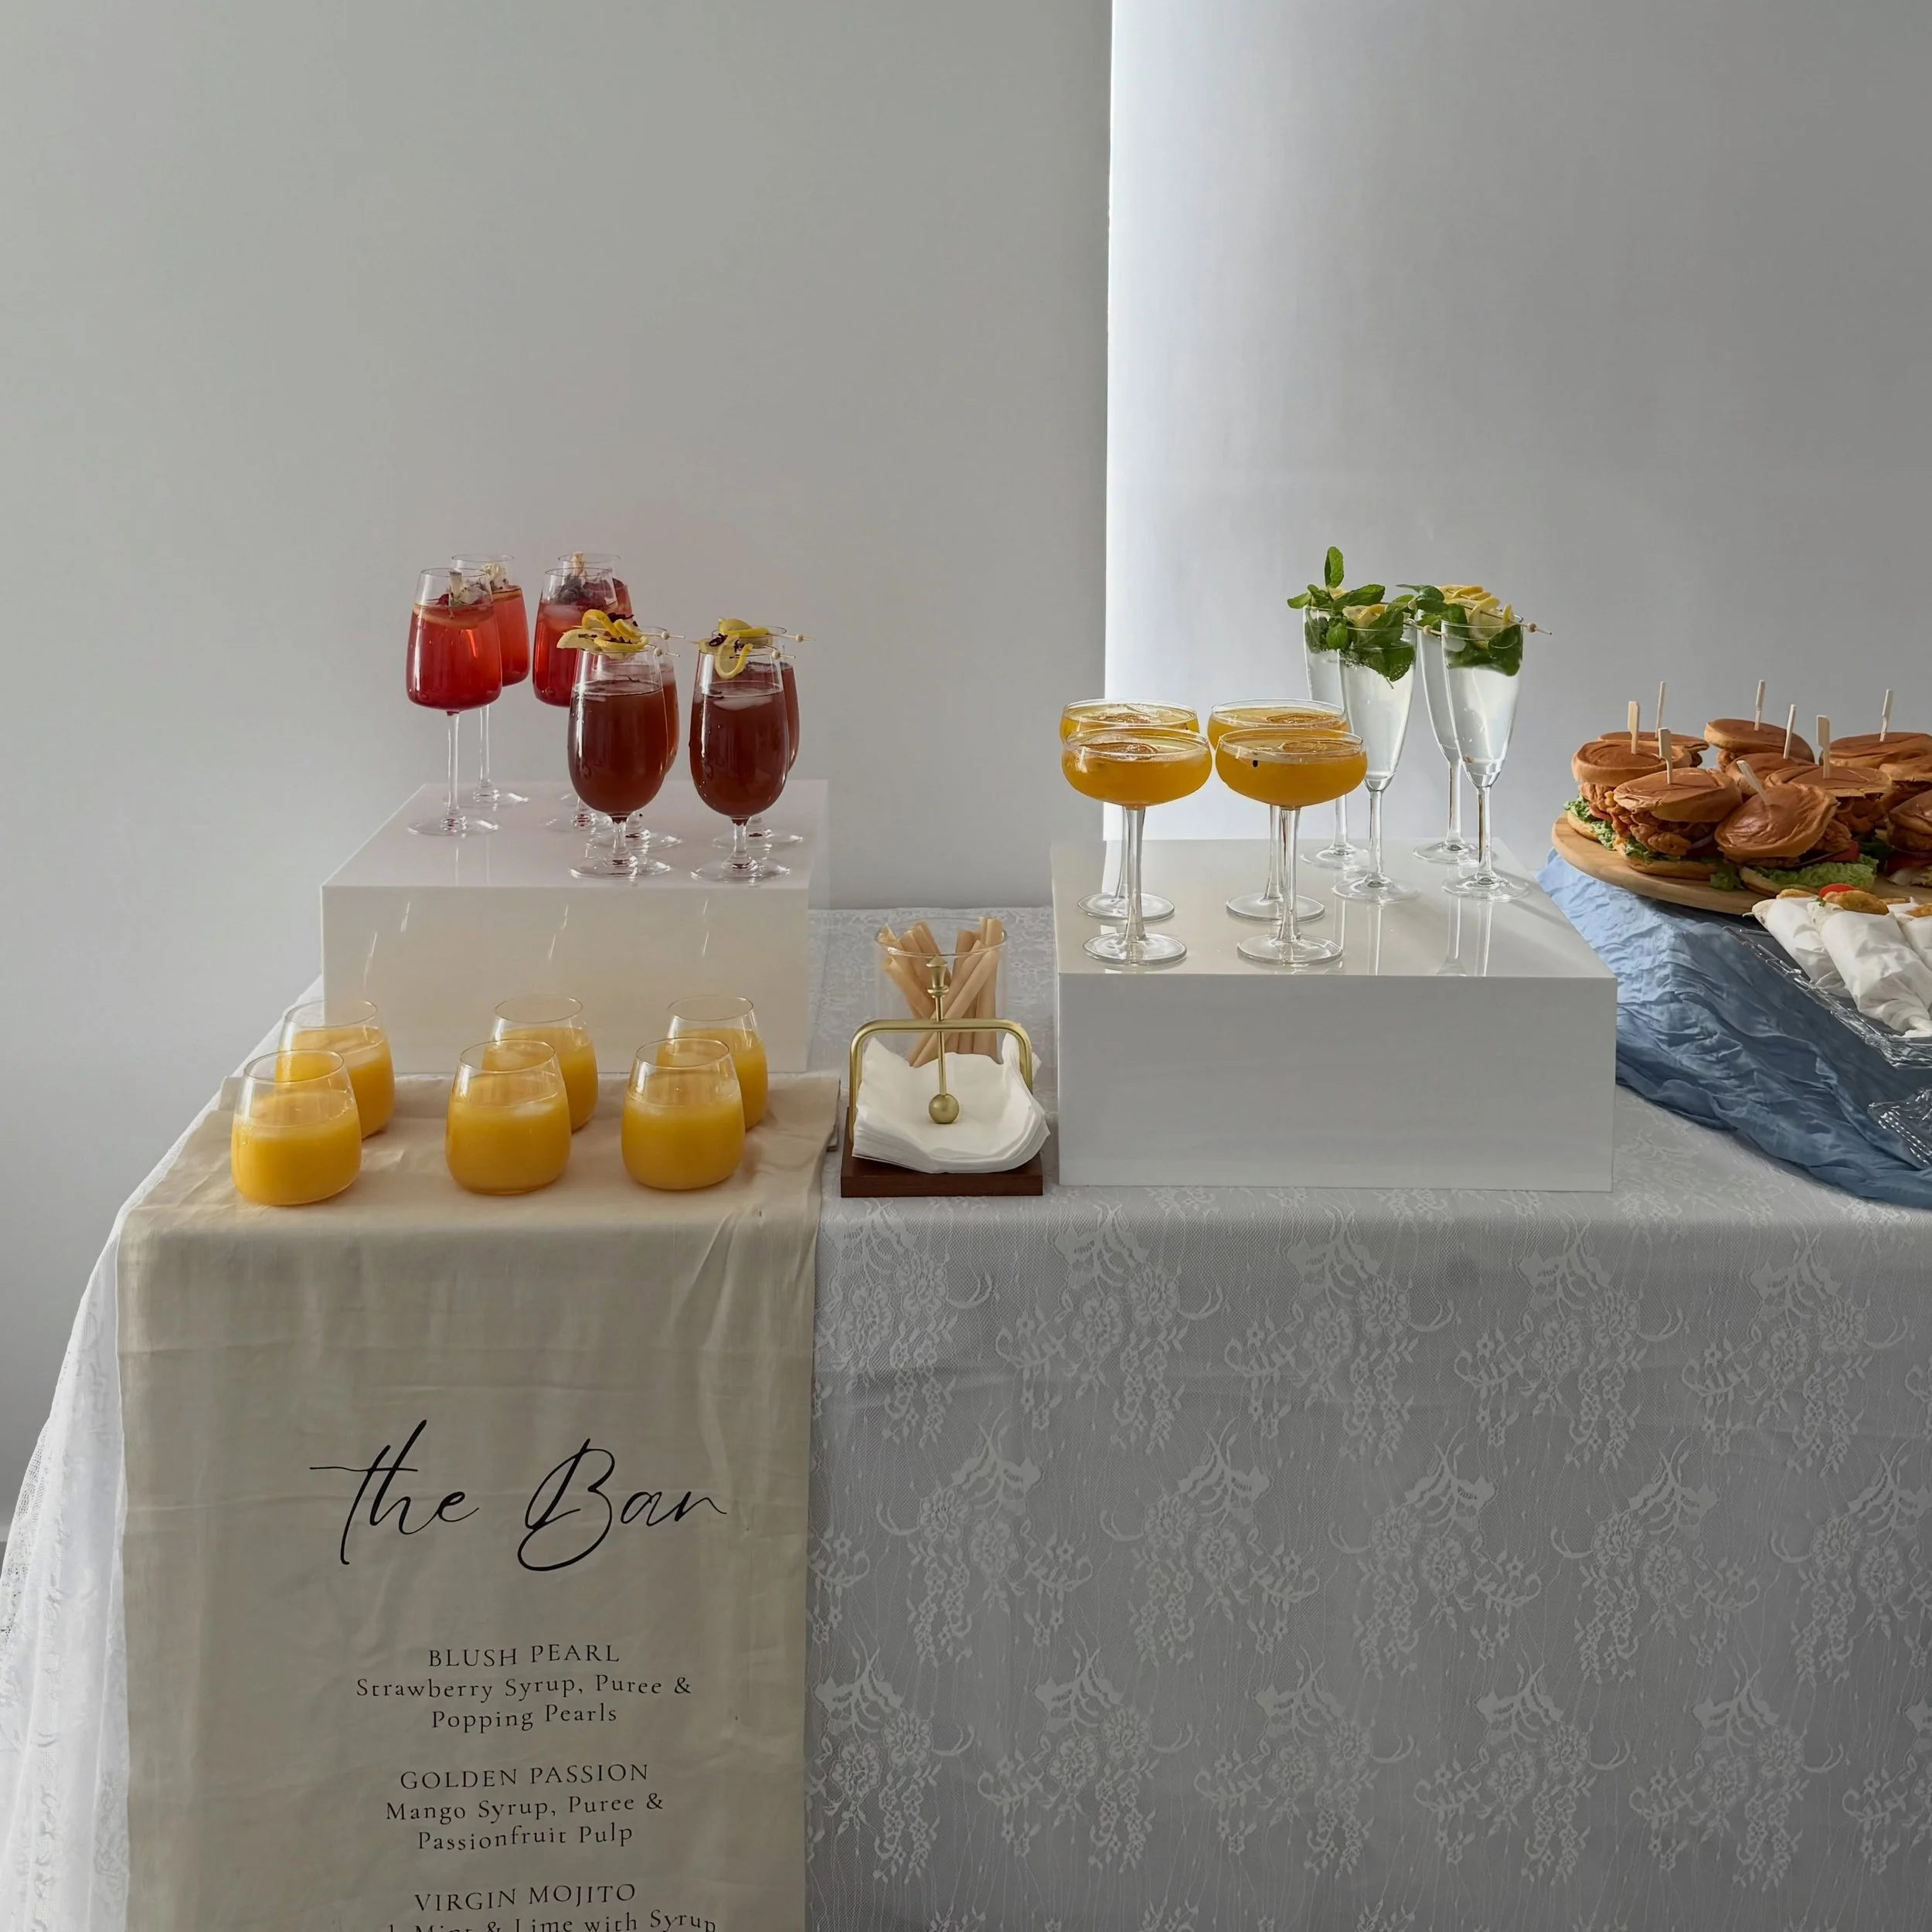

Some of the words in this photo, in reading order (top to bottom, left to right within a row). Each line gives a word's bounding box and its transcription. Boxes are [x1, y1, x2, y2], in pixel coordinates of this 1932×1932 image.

[308, 1419, 480, 1565] the
[517, 1437, 727, 1572] Bar
[428, 1648, 518, 1668] BLUSH
[530, 1644, 620, 1663] PEARL
[356, 1678, 493, 1703] Strawberry
[505, 1678, 583, 1702] Syrup,
[595, 1674, 662, 1694] Puree
[674, 1676, 692, 1694] &
[432, 1710, 533, 1734] Popping
[545, 1702, 617, 1723] Pearls
[400, 1768, 517, 1790] GOLDEN
[530, 1764, 648, 1784] PASSION
[386, 1802, 466, 1825] Mango
[478, 1800, 556, 1823] Syrup,
[568, 1795, 634, 1813] Puree
[646, 1792, 664, 1810] &
[418, 1825, 567, 1851] Passionfruit
[579, 1821, 633, 1848] Pulp
[414, 1888, 516, 1912] VIRGIN
[528, 1883, 636, 1907] MOJITO
[584, 1912, 637, 1932] with
[650, 1909, 716, 1932] Syrup
